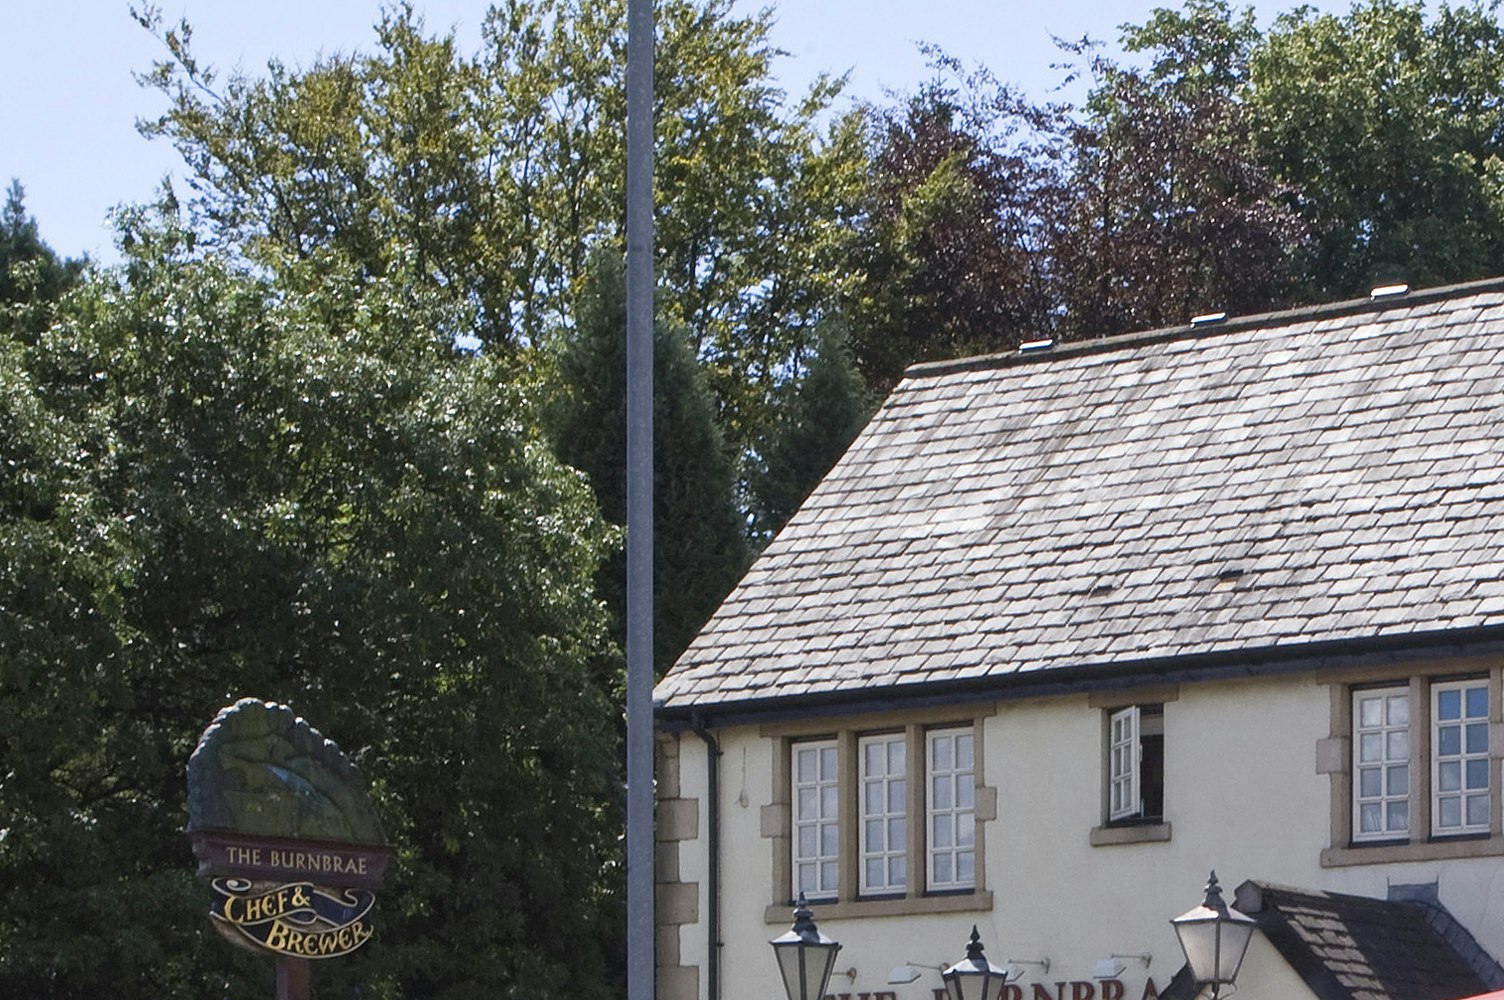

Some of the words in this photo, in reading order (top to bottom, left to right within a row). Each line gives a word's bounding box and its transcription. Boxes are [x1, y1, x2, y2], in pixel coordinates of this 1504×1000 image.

[226, 846, 262, 865] THE
[270, 850, 367, 875] BURNBRAE
[224, 887, 289, 924] CHEF
[291, 885, 311, 908] &
[265, 919, 374, 955] BREWER
